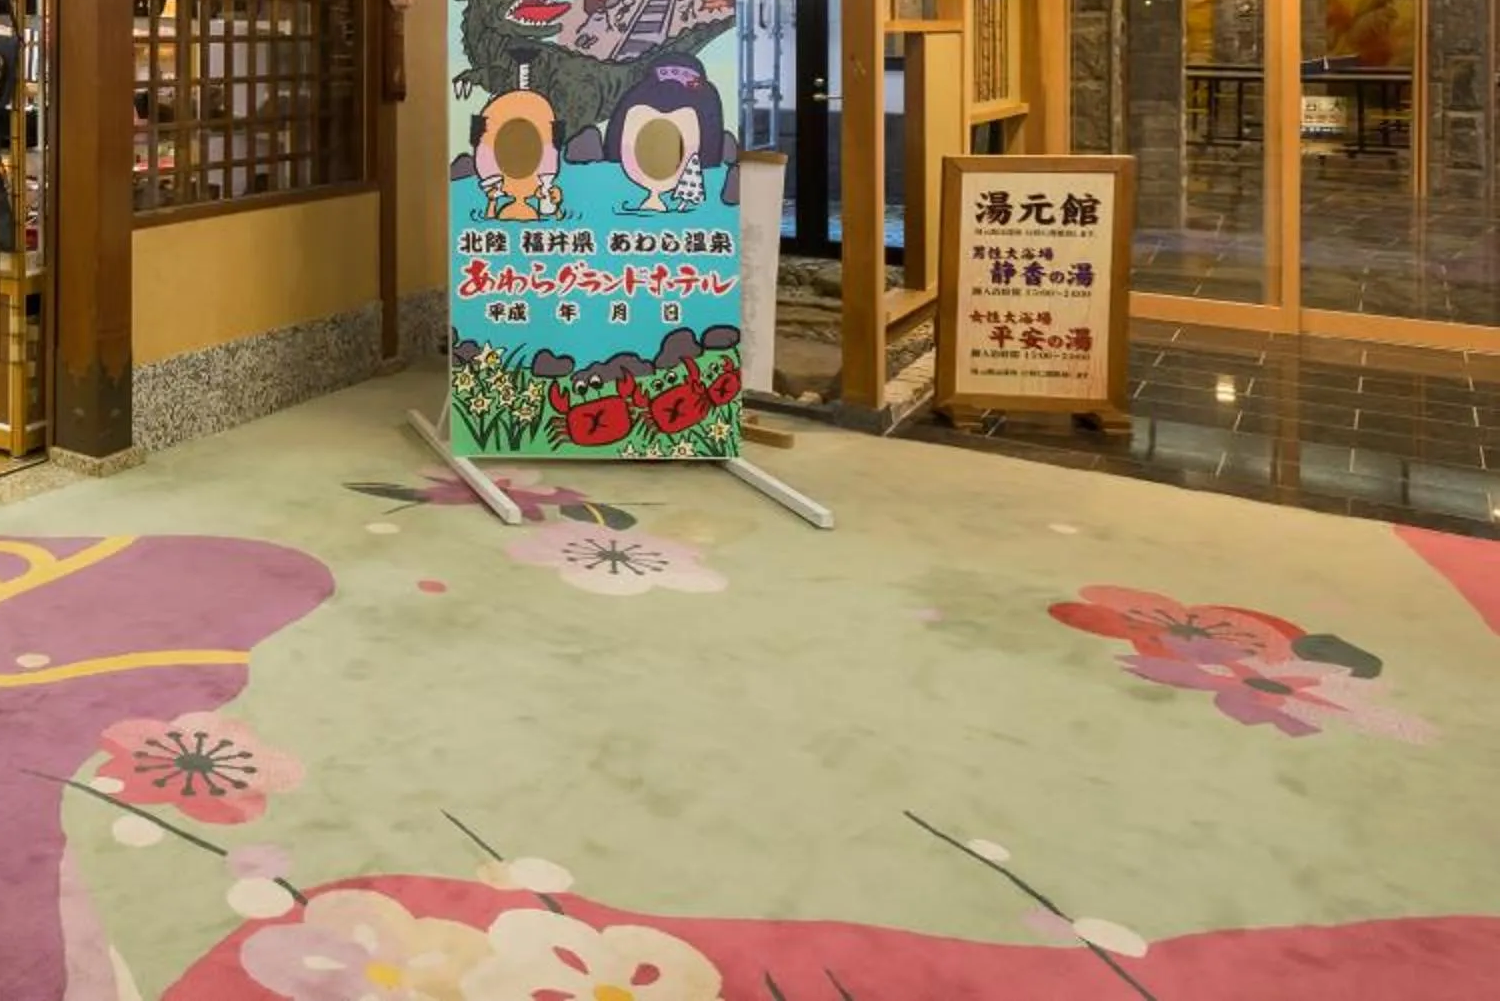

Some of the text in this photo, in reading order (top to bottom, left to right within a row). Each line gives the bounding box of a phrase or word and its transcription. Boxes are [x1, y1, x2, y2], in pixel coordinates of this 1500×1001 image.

[974, 190, 1102, 227] 湯元館
[458, 228, 734, 255] 北陸 福井県 あわら温泉
[971, 245, 1055, 261] 男性大浴場
[456, 260, 740, 298] あわらグランドホテル
[990, 261, 1096, 288] 静香の湯
[486, 302, 681, 323] 平成 年 月 日
[968, 310, 1053, 326] 女性大浴場
[988, 325, 1094, 353] 平安の湯
